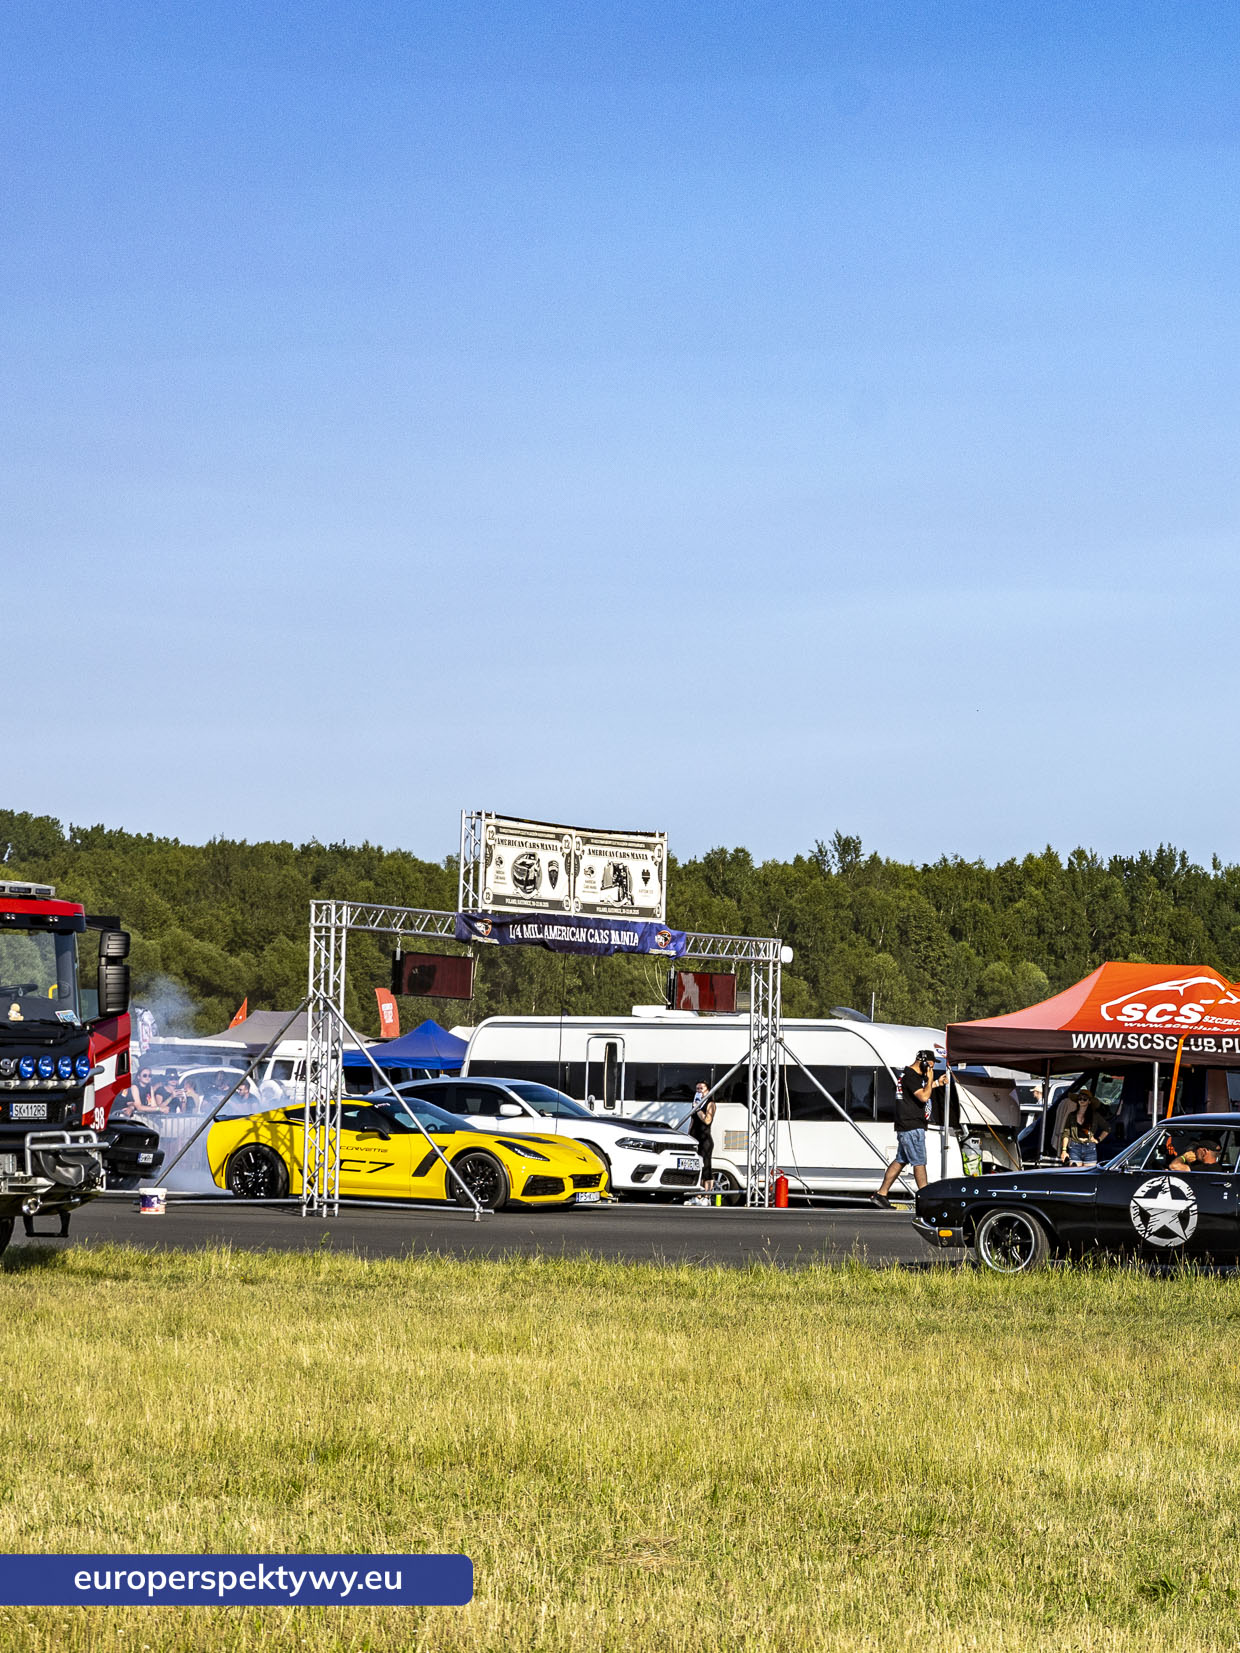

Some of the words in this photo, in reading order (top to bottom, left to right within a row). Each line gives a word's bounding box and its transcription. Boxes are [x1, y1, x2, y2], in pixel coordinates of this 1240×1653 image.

[488, 830, 495, 841] 12
[497, 838, 525, 848] AMERICAN
[525, 840, 539, 849] CARS
[540, 842, 558, 851] MANIA
[587, 848, 615, 857] AMERICAN
[615, 850, 630, 859] CARS
[630, 852, 648, 860] MANIA
[509, 924, 522, 939] 1/4
[544, 925, 588, 943] AMERICAN
[587, 928, 610, 945] CARS
[610, 930, 639, 946] MANIA
[1117, 1003, 1205, 1024] SCS
[14, 1104, 23, 1116] SK
[26, 1104, 46, 1117] 112RS
[90, 1107, 105, 1130] 98
[339, 1145, 388, 1153] CORVETTE
[339, 1159, 395, 1173] C7
